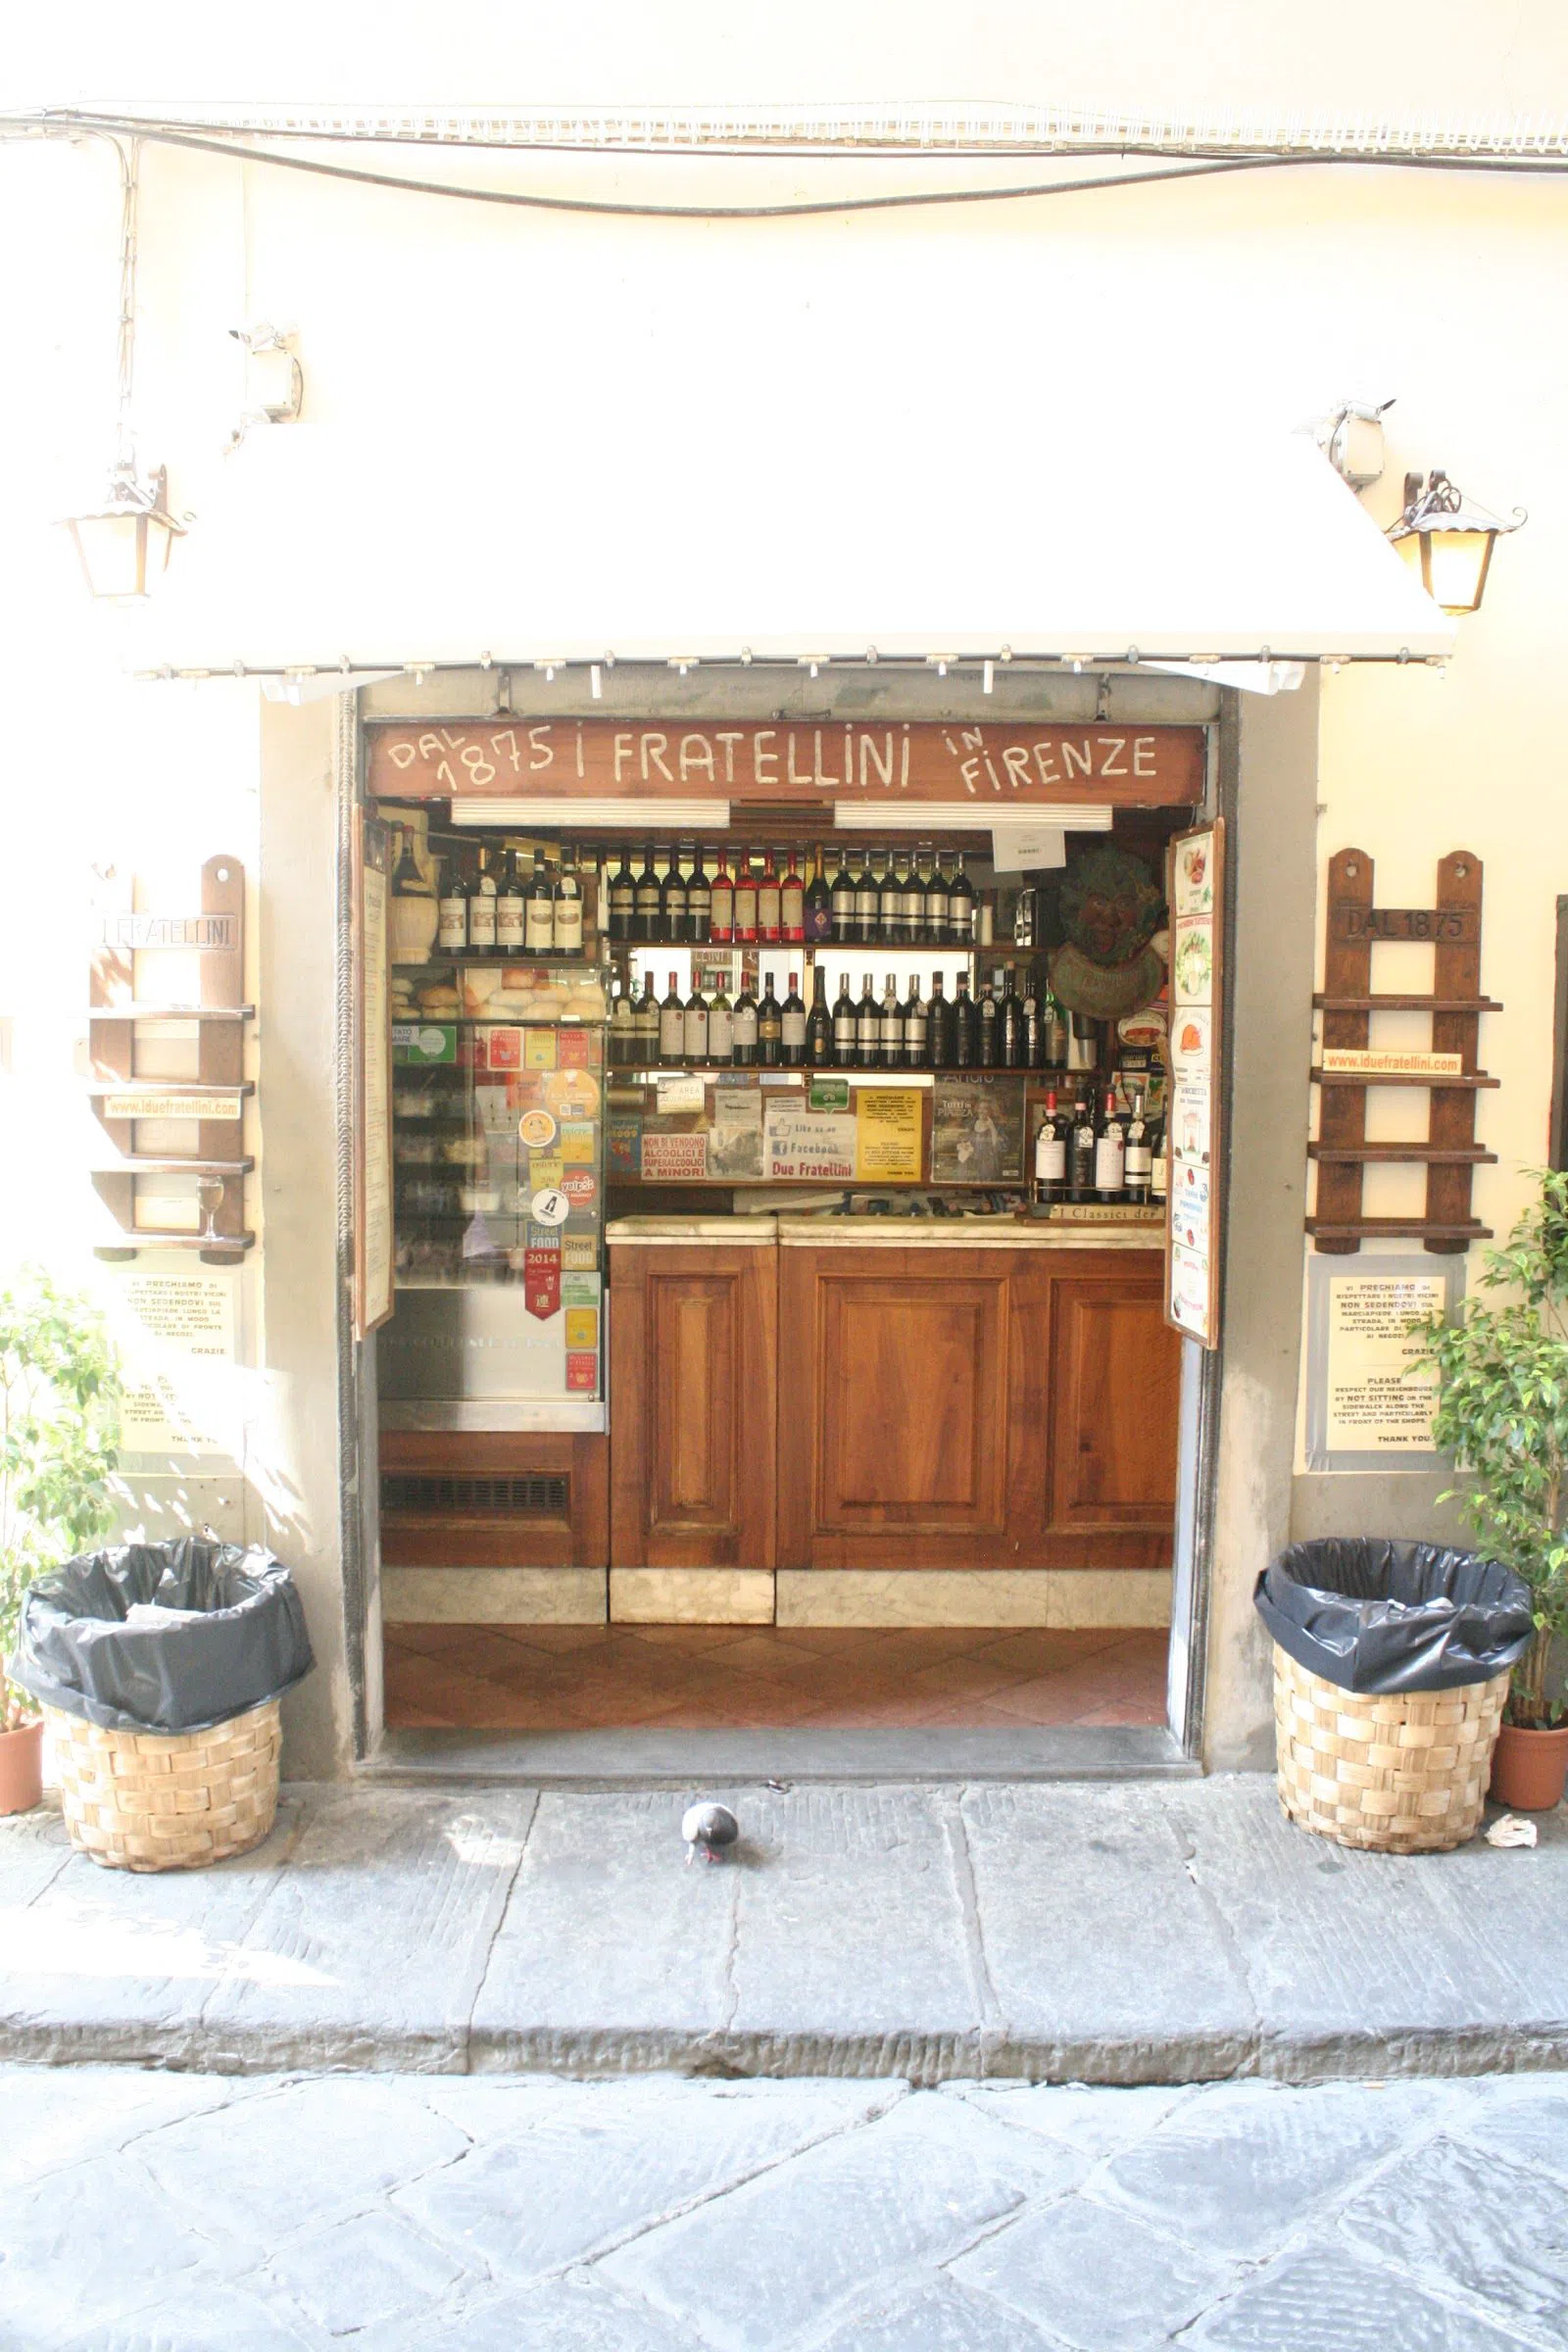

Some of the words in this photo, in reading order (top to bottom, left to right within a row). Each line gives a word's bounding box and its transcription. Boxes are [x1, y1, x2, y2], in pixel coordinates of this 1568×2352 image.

[388, 728, 466, 769] DAL
[437, 725, 554, 791] 1875
[118, 918, 230, 944] FRATELLINI
[1347, 911, 1396, 937] DAL
[1404, 912, 1462, 937] 1875
[1328, 1054, 1457, 1071] www.iduefratellini.com
[643, 1137, 659, 1146] NON
[791, 1143, 840, 1153] Facebook
[772, 1161, 794, 1175] Due
[800, 1161, 852, 1176] Fratellini
[562, 1181, 583, 1192] yelp
[564, 1241, 592, 1250] Street
[528, 1253, 558, 1263] 2014
